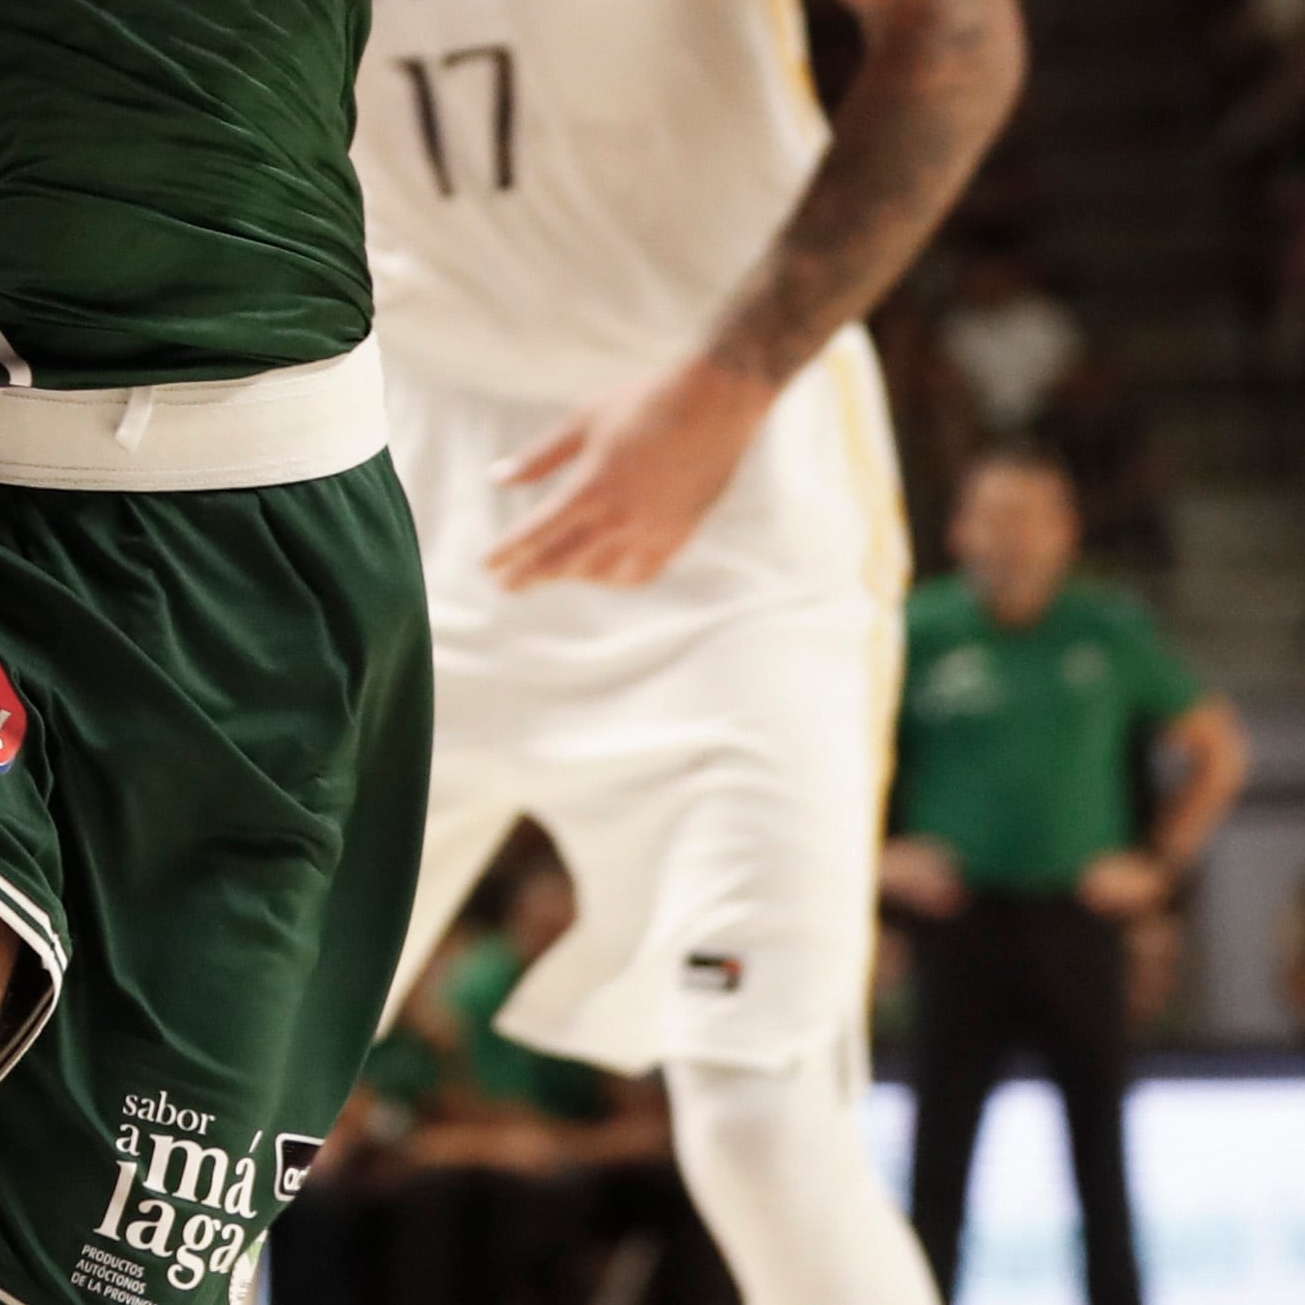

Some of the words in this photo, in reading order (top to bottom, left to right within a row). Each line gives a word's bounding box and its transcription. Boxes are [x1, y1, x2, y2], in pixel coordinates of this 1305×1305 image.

[392, 42, 515, 197] 17
[122, 1091, 216, 1136] sabor
[115, 1123, 140, 1157] a
[142, 1130, 263, 1219] má
[93, 1160, 246, 1291] laga
[71, 1272, 87, 1287] DE
[87, 1279, 102, 1294] LA
[75, 1259, 147, 1295] AUTÓCTONOS
[81, 1244, 145, 1278] PRODUCTOS
